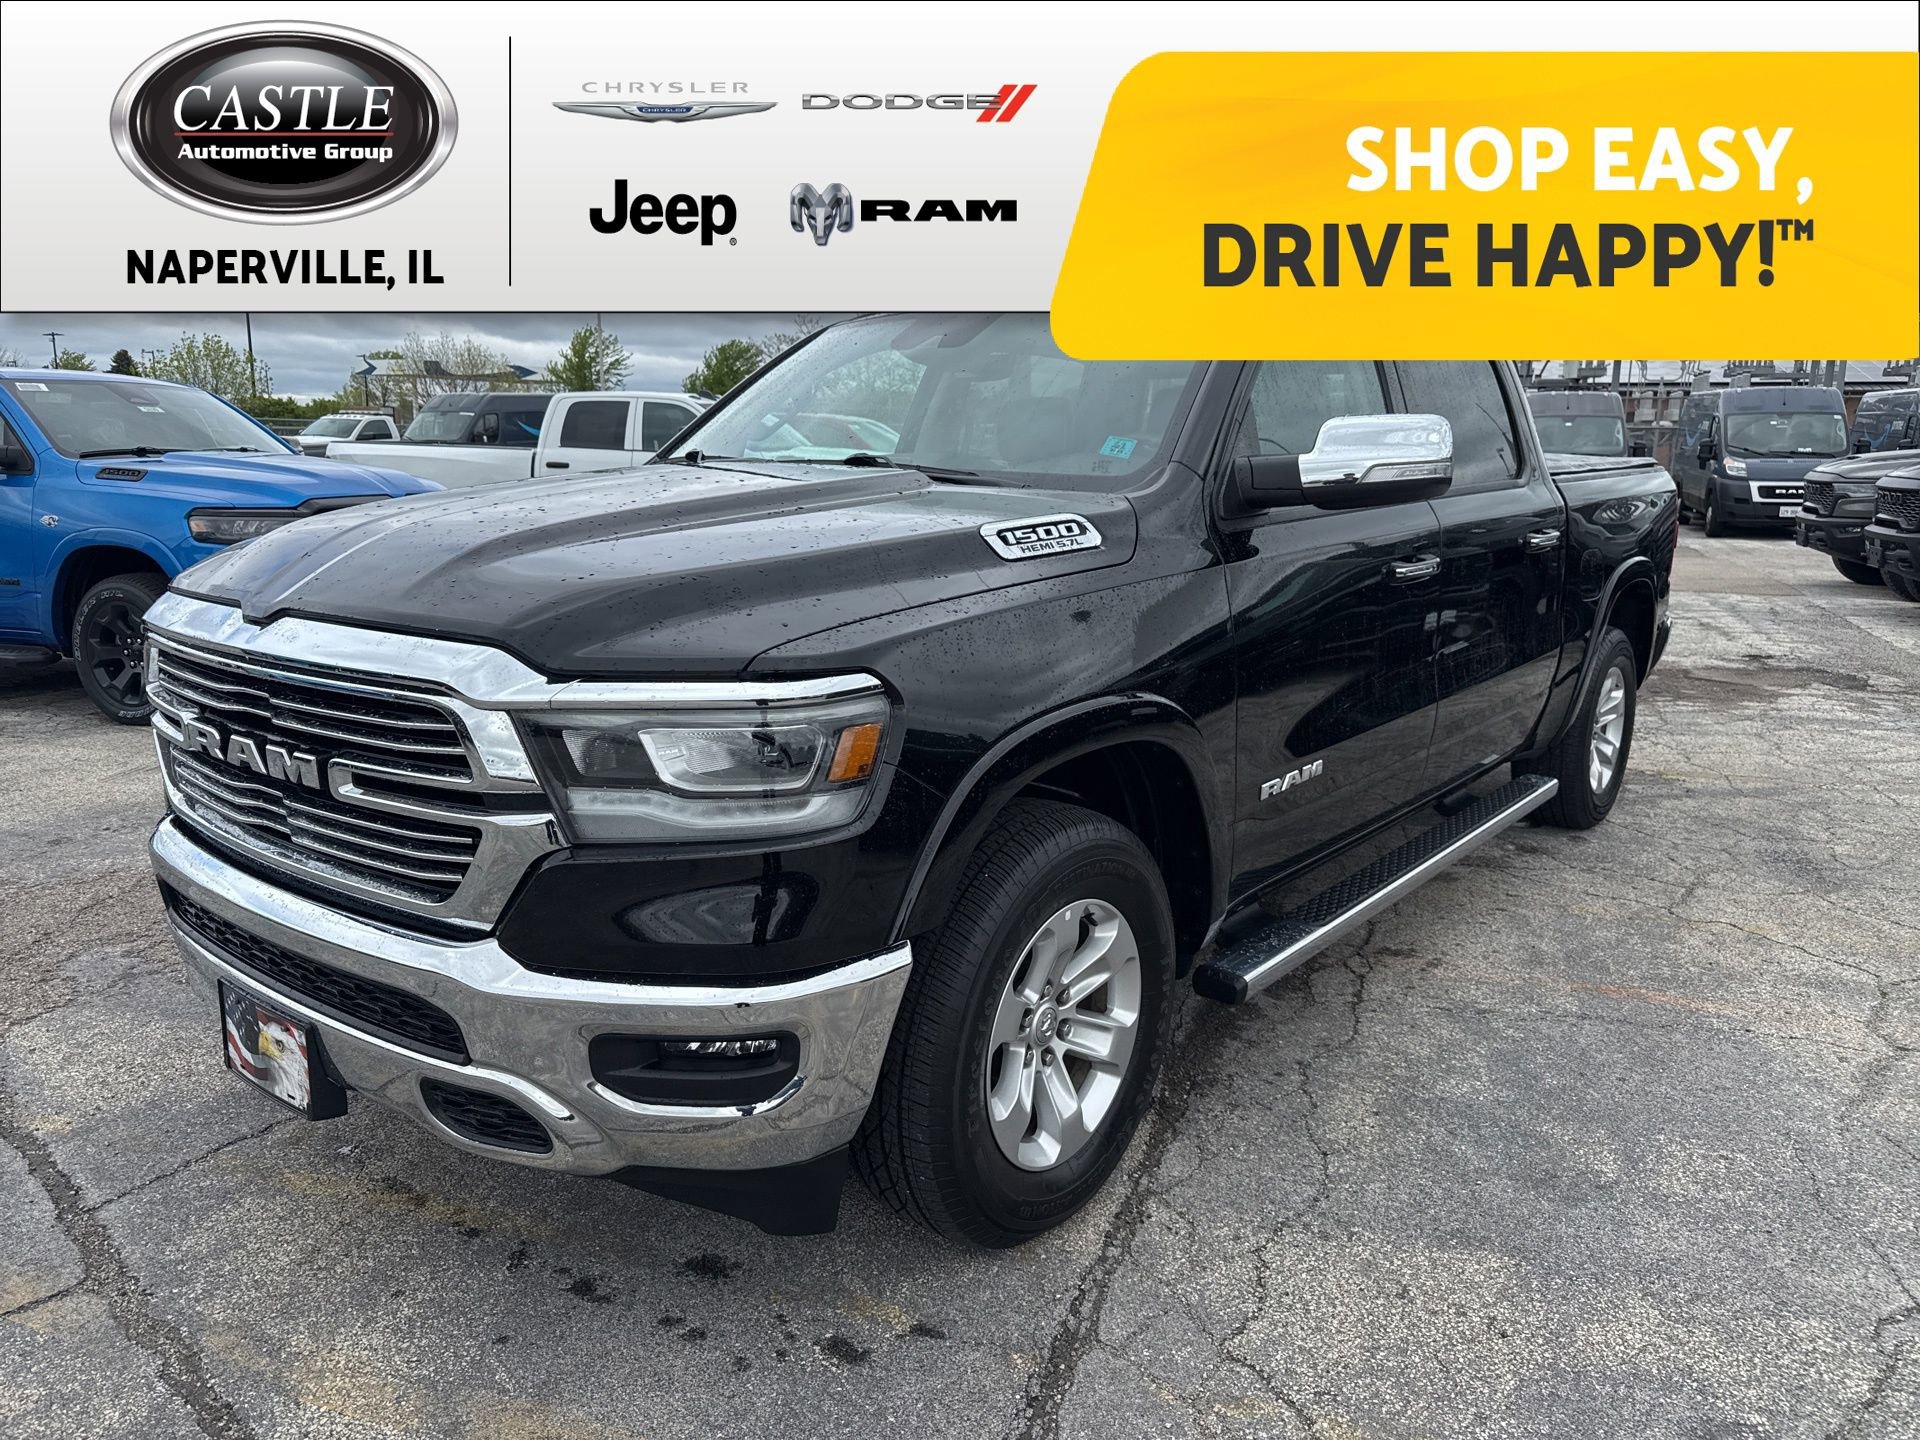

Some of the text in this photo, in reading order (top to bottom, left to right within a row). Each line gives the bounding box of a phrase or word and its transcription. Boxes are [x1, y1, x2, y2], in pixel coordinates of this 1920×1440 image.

[1000, 522, 1081, 545] 1500
[1020, 538, 1084, 554] HEMI 5.7L
[187, 719, 321, 790] RAM
[1259, 759, 1323, 801] RAM
